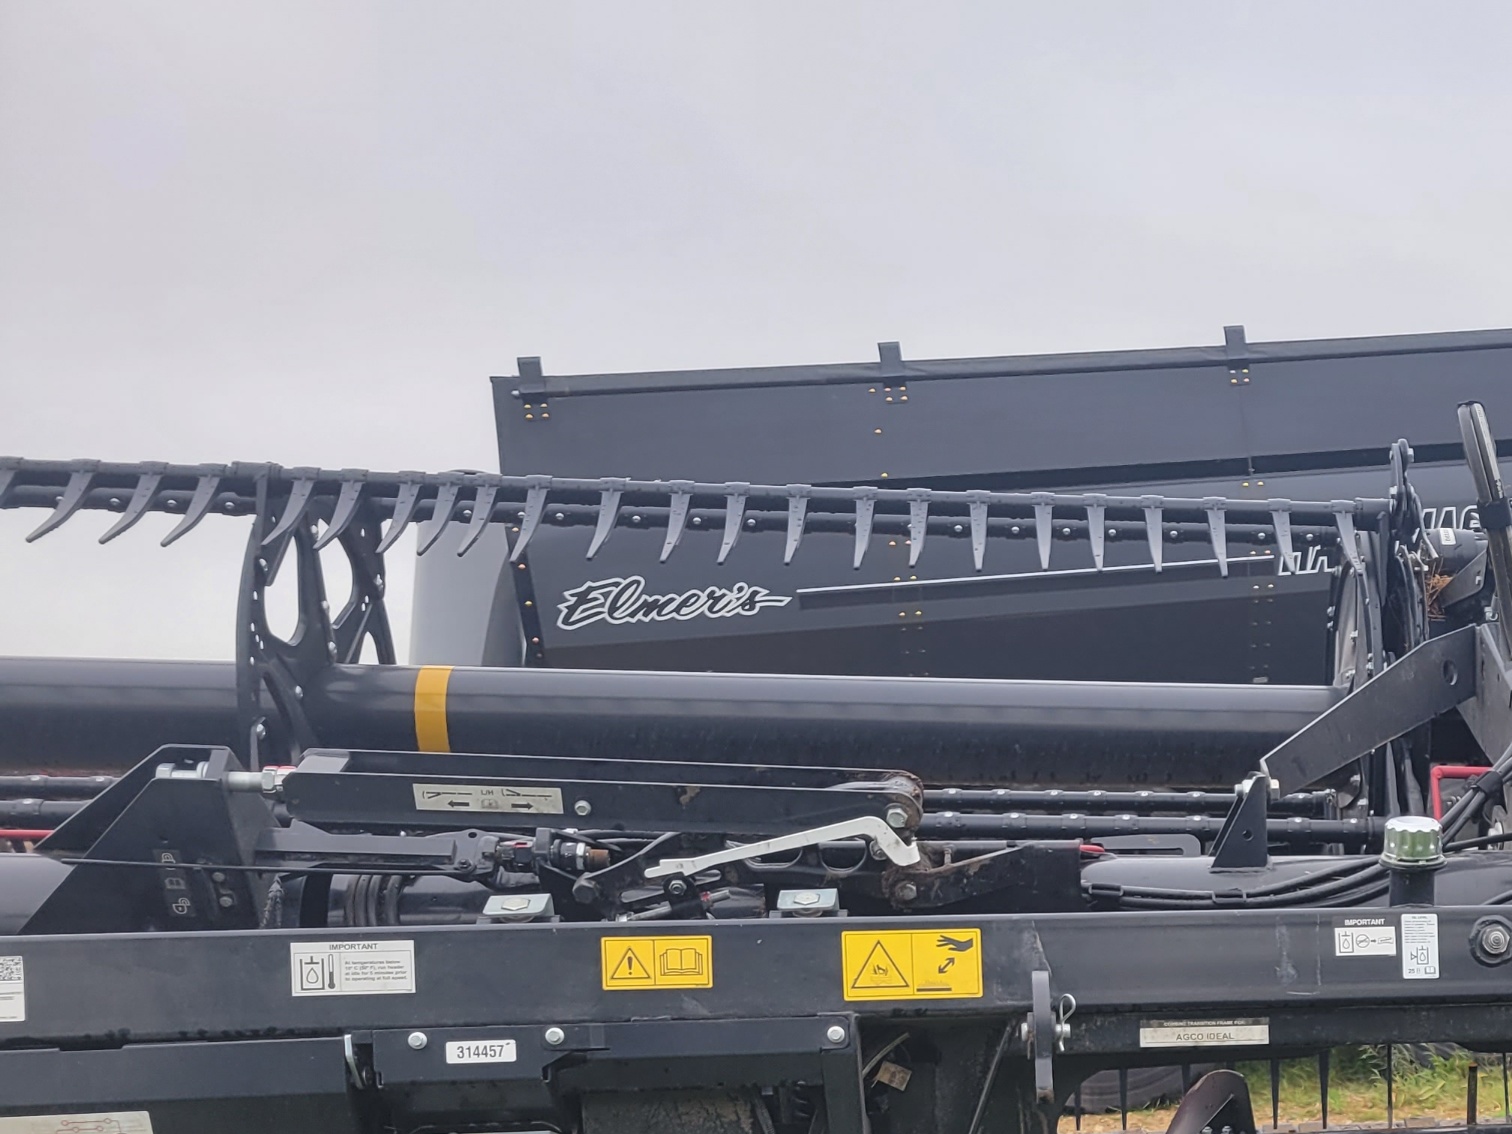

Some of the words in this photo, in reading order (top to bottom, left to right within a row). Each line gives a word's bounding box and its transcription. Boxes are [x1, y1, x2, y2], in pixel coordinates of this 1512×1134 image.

[557, 575, 792, 630] Elmer's
[1344, 918, 1386, 926] IMPORTANT
[329, 943, 378, 951] IMPORTANT
[1176, 1033, 1204, 1041] AGCO
[1206, 1032, 1235, 1040] IDEAL
[456, 1044, 504, 1059] 314457
